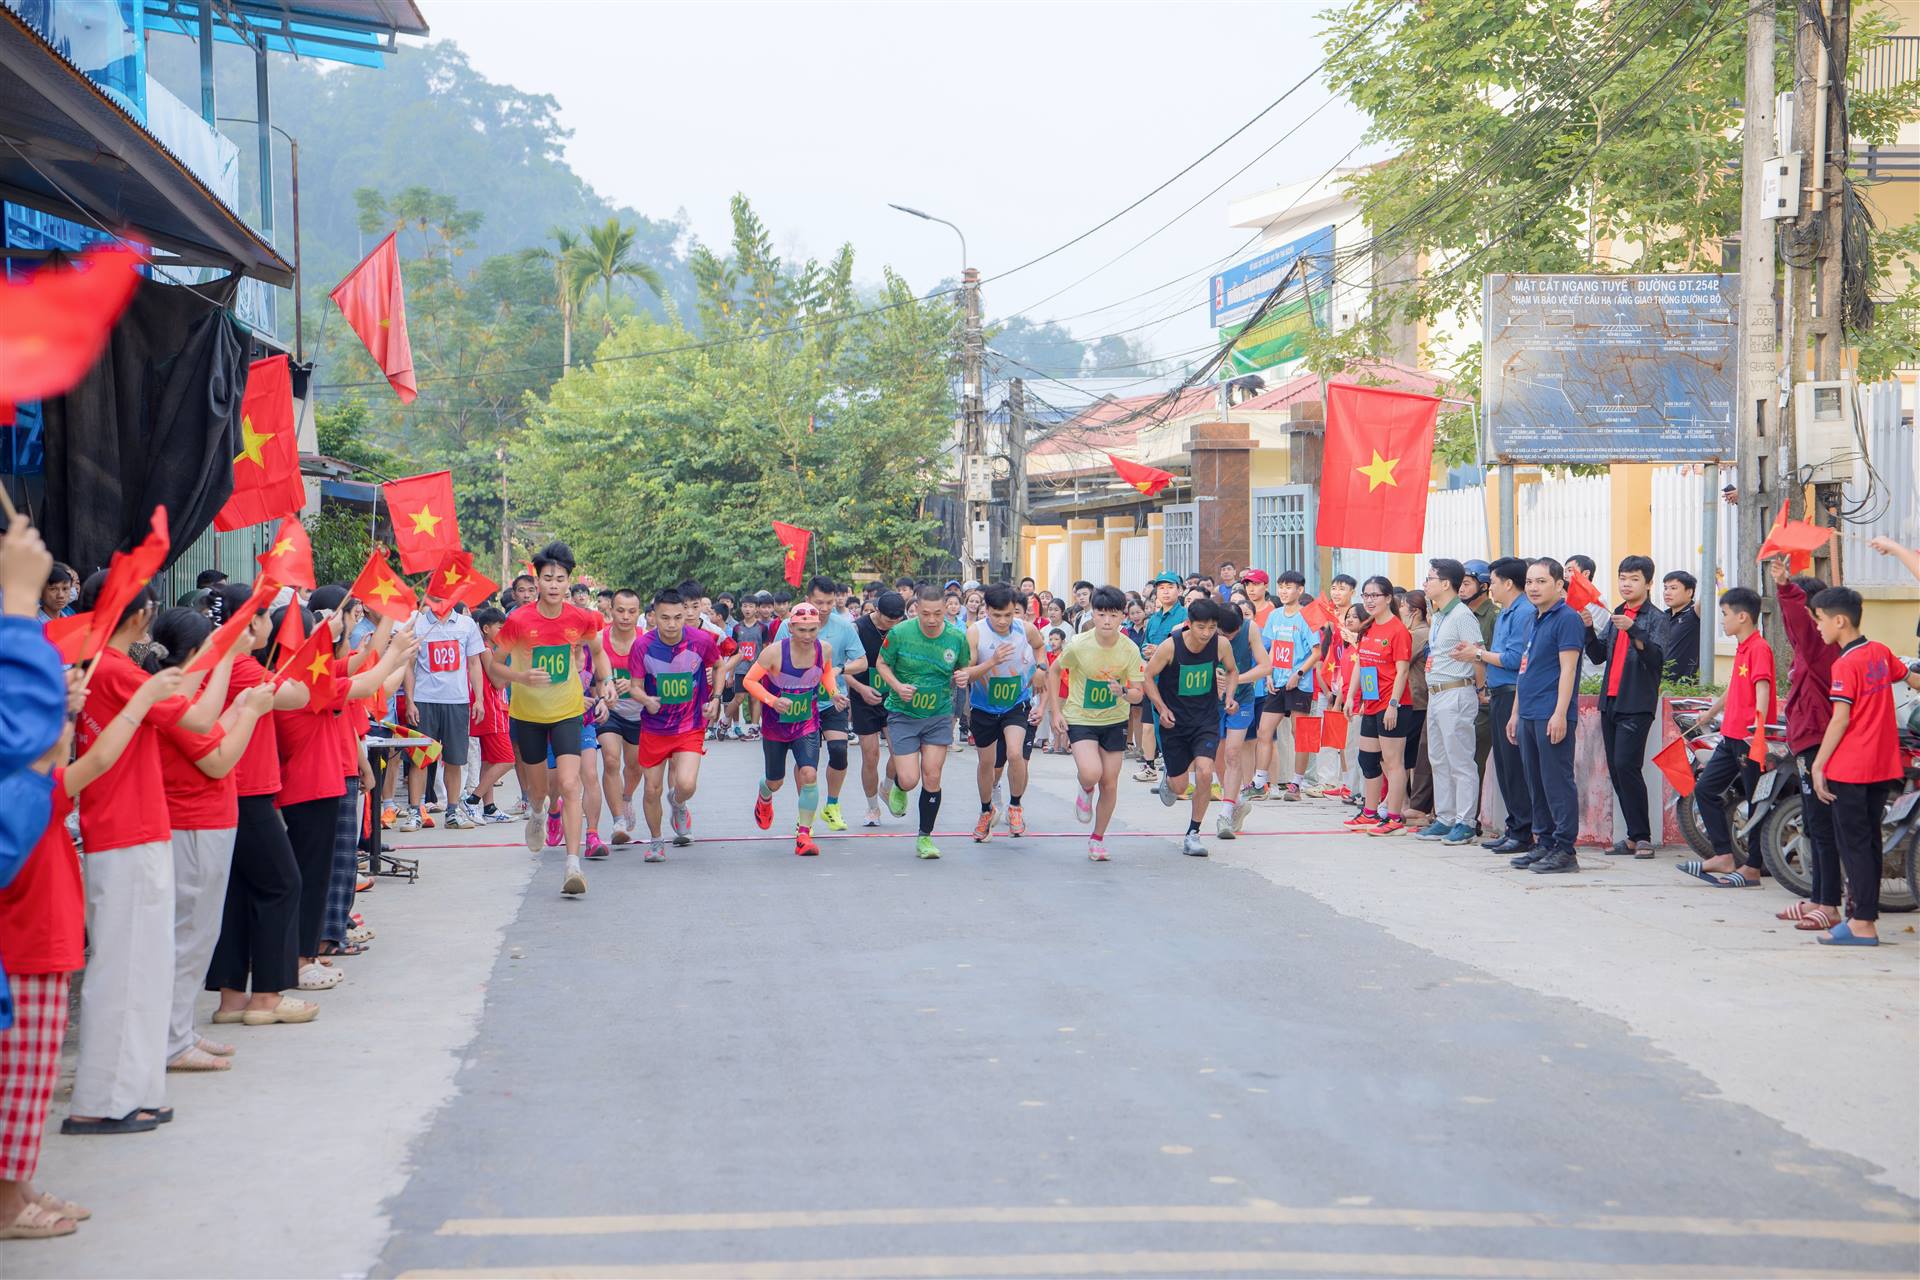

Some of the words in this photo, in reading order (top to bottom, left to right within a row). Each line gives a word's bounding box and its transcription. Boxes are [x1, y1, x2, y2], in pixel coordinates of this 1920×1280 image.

[1515, 279, 1537, 293] MẶT
[1539, 277, 1559, 291] CẮT
[1562, 281, 1599, 291] NGANG
[1601, 278, 1628, 291] TUYẾ
[1638, 278, 1676, 291] ĐƯỜNG
[1533, 296, 1540, 304] VI
[1541, 293, 1557, 304] BẢO
[1559, 295, 1568, 306] VỆ
[1569, 293, 1582, 304] KẾT
[1585, 293, 1600, 304] CẤU
[1601, 296, 1612, 306] HẠ
[1634, 295, 1653, 305] GIAO
[1681, 292, 1708, 304] ĐƯỜNG
[1710, 293, 1721, 306] BỘ
[434, 648, 455, 664] 029
[1275, 646, 1290, 662] 042
[538, 653, 564, 674] 016
[1186, 670, 1207, 688] 011
[662, 679, 688, 697] 006
[993, 683, 1017, 701] 007
[912, 692, 937, 709] 002
